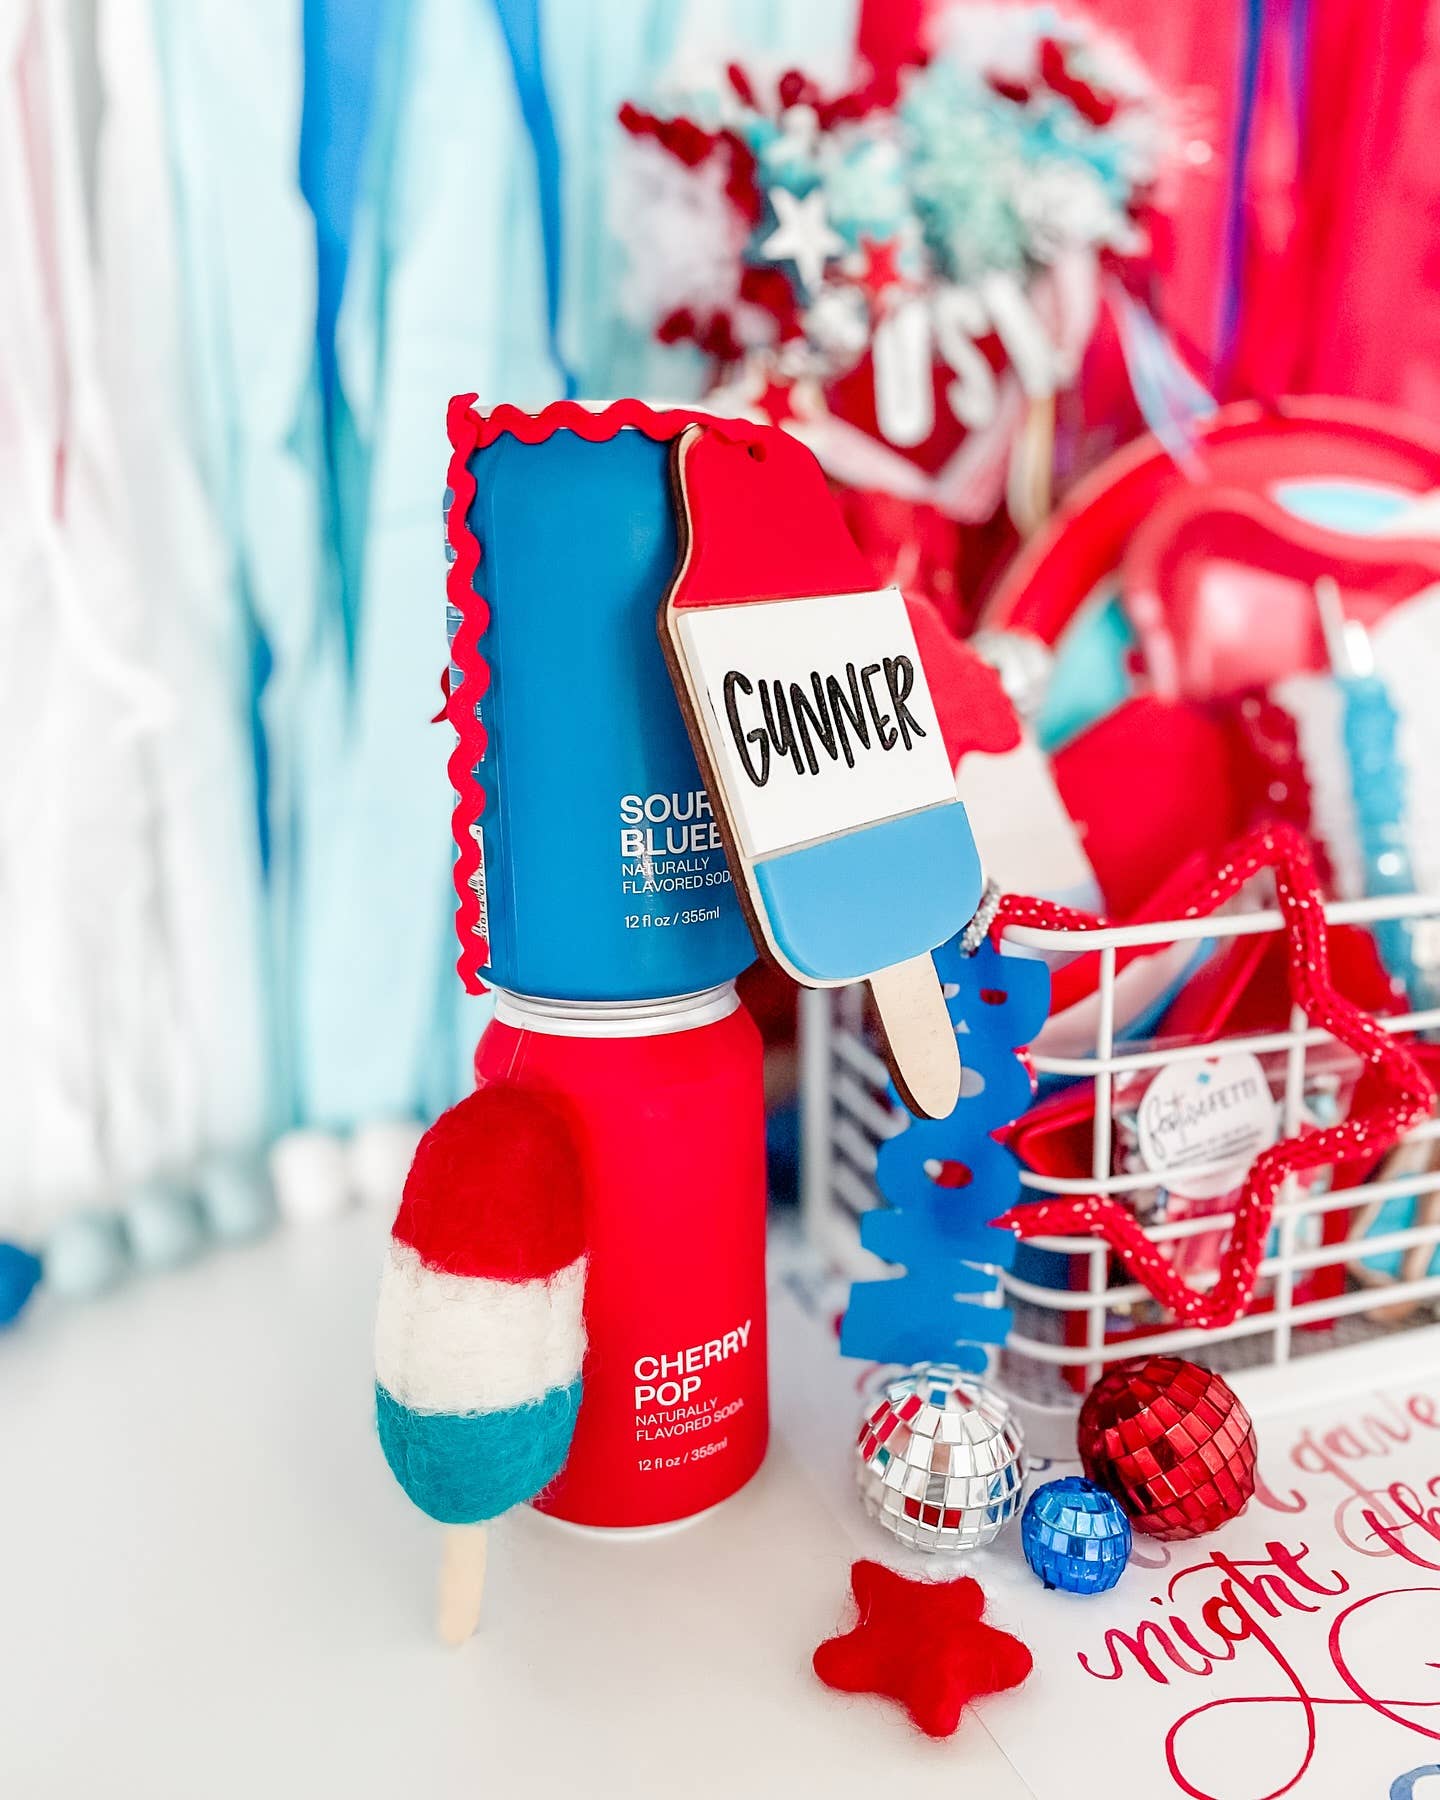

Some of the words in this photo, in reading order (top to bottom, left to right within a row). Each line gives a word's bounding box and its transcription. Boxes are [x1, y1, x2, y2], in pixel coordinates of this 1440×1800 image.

[723, 655, 926, 787] GUNNER
[620, 790, 714, 825] SOUR
[622, 856, 710, 877] NATURALLY
[622, 875, 703, 894] FLAVORED
[705, 870, 732, 887] SOD
[624, 915, 639, 929] 12
[642, 914, 651, 927] fl
[654, 916, 670, 927] oz
[681, 906, 720, 924] 355ml
[634, 1319, 751, 1381] CHERRY
[634, 1376, 702, 1410] POP
[635, 1397, 718, 1427] NATURALLY
[636, 1415, 712, 1441] FLAVORED
[713, 1397, 744, 1423] SODA
[638, 1460, 652, 1471] 12
[655, 1457, 663, 1469] fl
[665, 1457, 681, 1468] oz
[691, 1437, 727, 1461] 355ml
